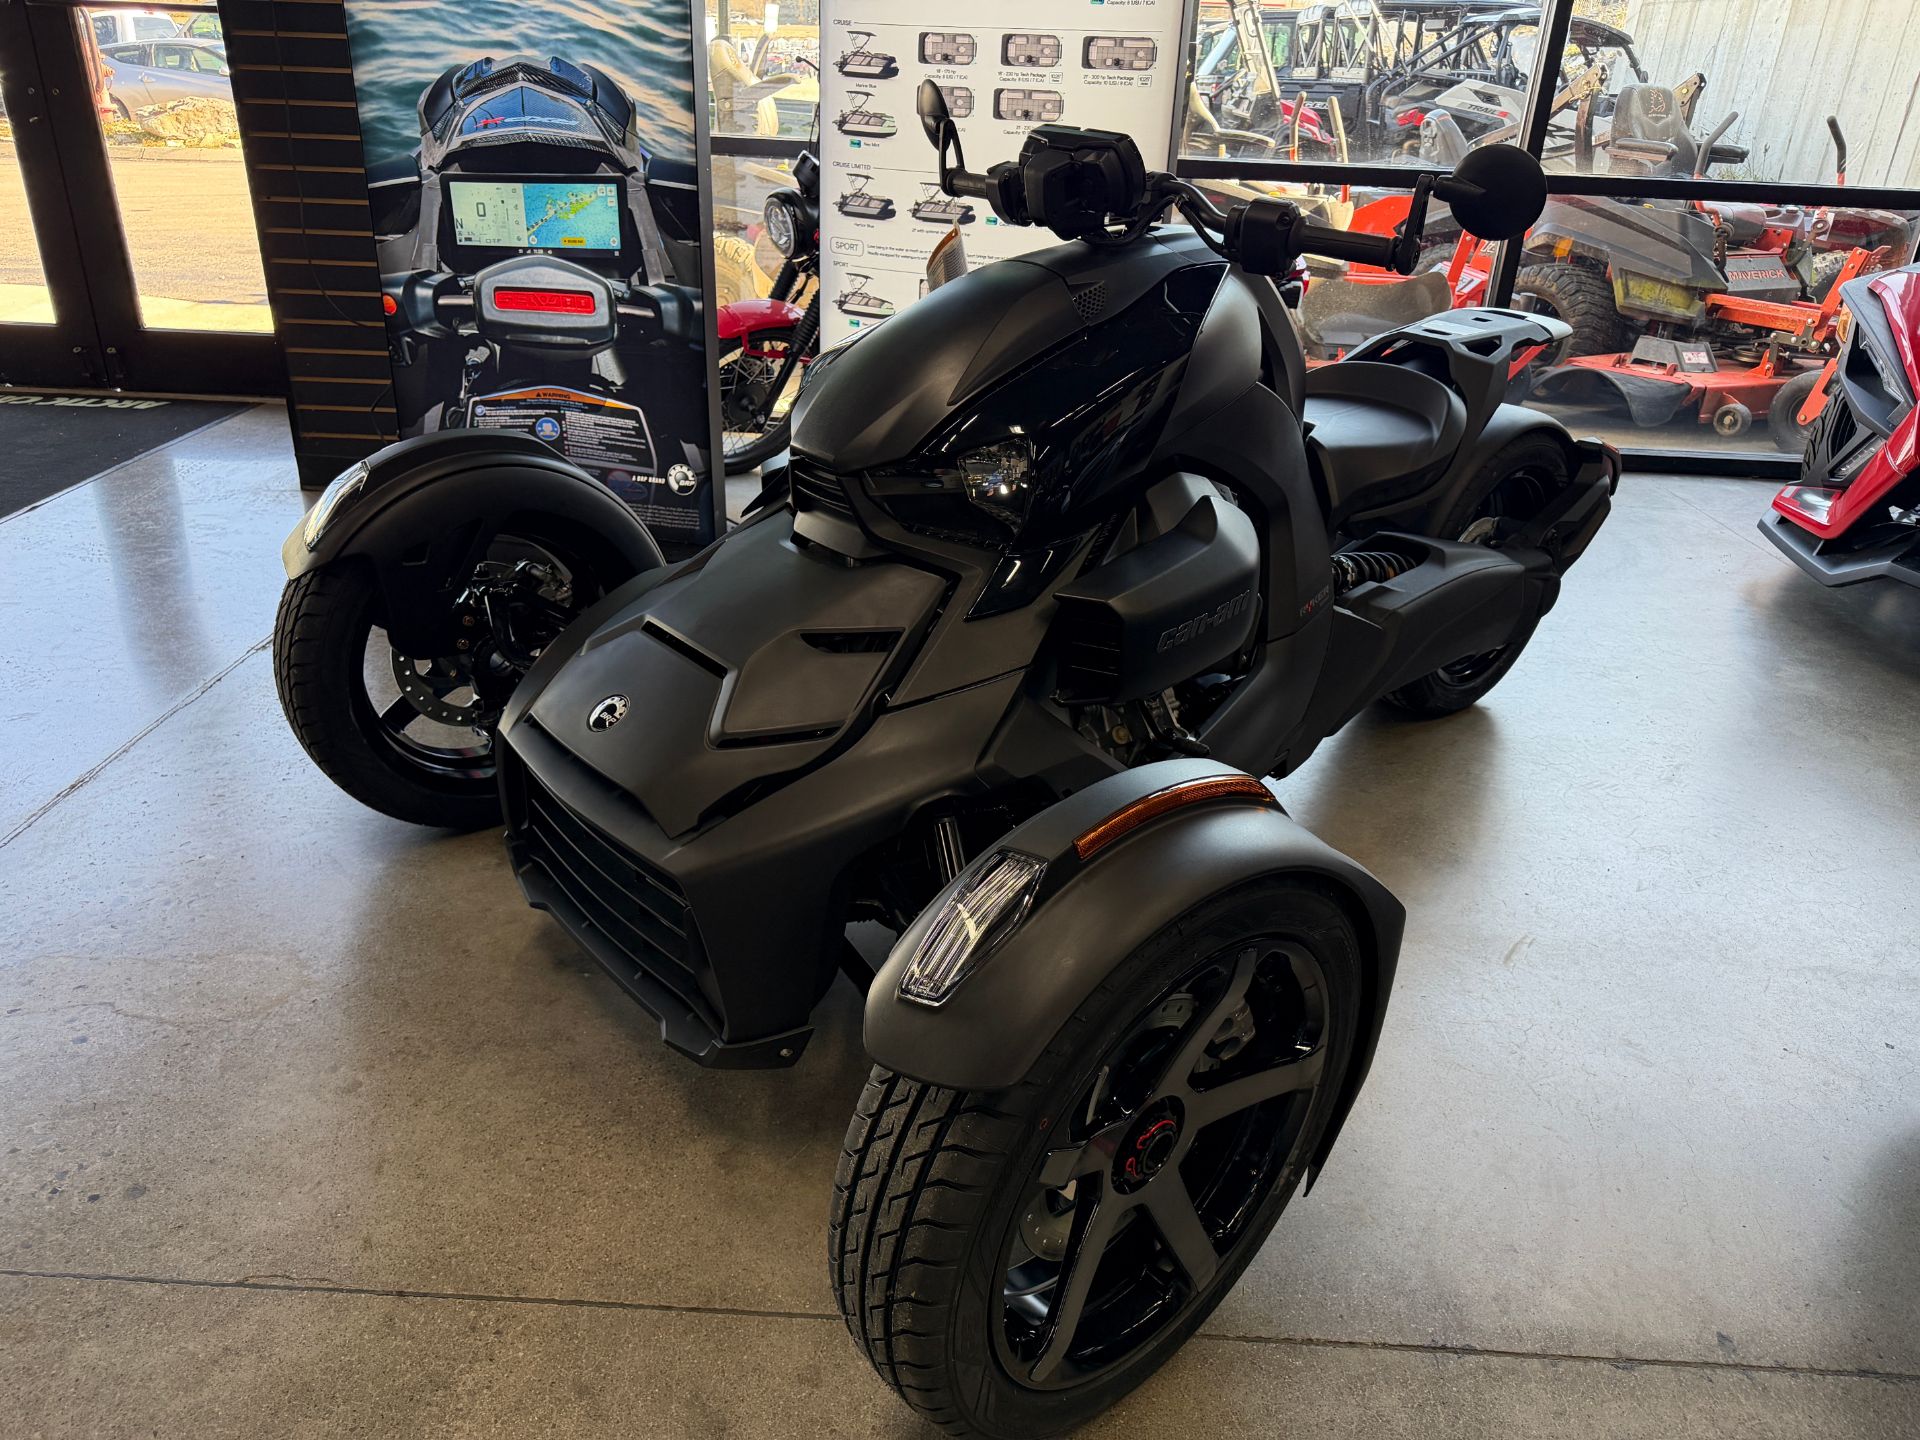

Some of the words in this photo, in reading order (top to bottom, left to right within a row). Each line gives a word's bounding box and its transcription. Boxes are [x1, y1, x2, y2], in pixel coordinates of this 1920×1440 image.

[1467, 104, 1497, 114] TRAIL
[832, 161, 850, 169] CRUISE
[851, 162, 871, 170] LIMITED
[456, 218, 464, 230] N
[835, 242, 858, 251] SPORT
[1728, 269, 1785, 280] MAVERICK
[0, 395, 44, 404] CA
[34, 396, 172, 410] ARCTIC
[648, 476, 666, 484] BRAND
[600, 711, 617, 728] BRP
